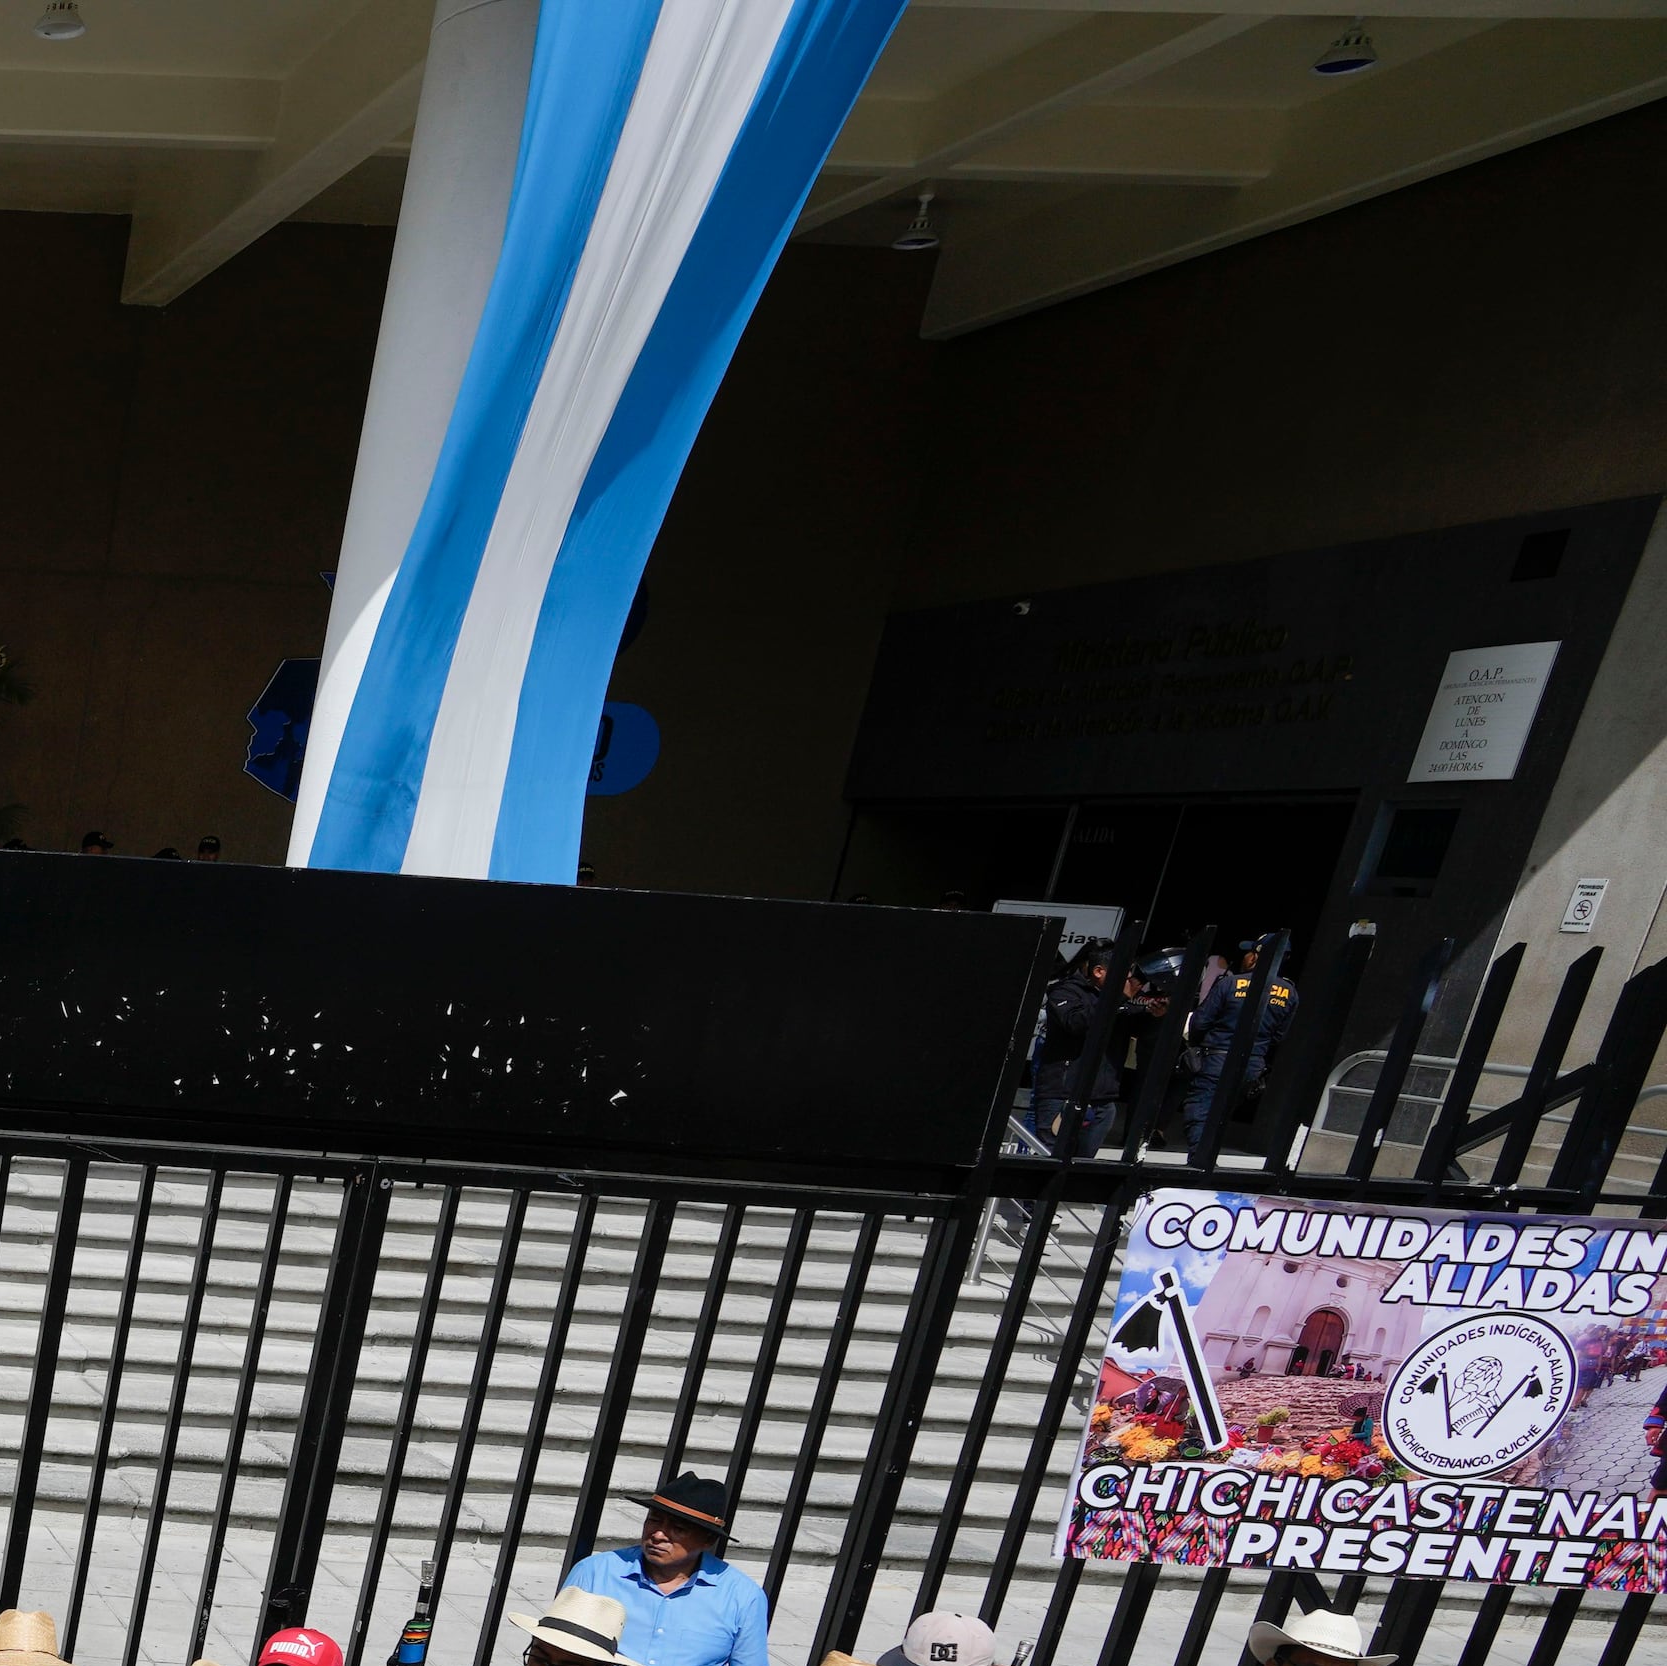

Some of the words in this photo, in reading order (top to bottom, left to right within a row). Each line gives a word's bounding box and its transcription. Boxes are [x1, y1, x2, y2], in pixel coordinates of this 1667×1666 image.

[1469, 667, 1504, 682] O.A.P.
[1453, 692, 1506, 706] ATENCION
[1454, 717, 1487, 728] LUNES
[1439, 740, 1488, 751] DOMINGO
[1146, 1201, 1597, 1271] COMUNIDADES
[1381, 1260, 1657, 1317] ALIADAS
[1399, 1326, 1486, 1405] COMUNIDADES
[1489, 1323, 1557, 1359] INDÍGENAS
[1543, 1358, 1564, 1413] ALIADAS
[1496, 1424, 1543, 1460] QUICHÉ
[1226, 1520, 1598, 1587] PRESENTE
[269, 1641, 309, 1659] PUMA
